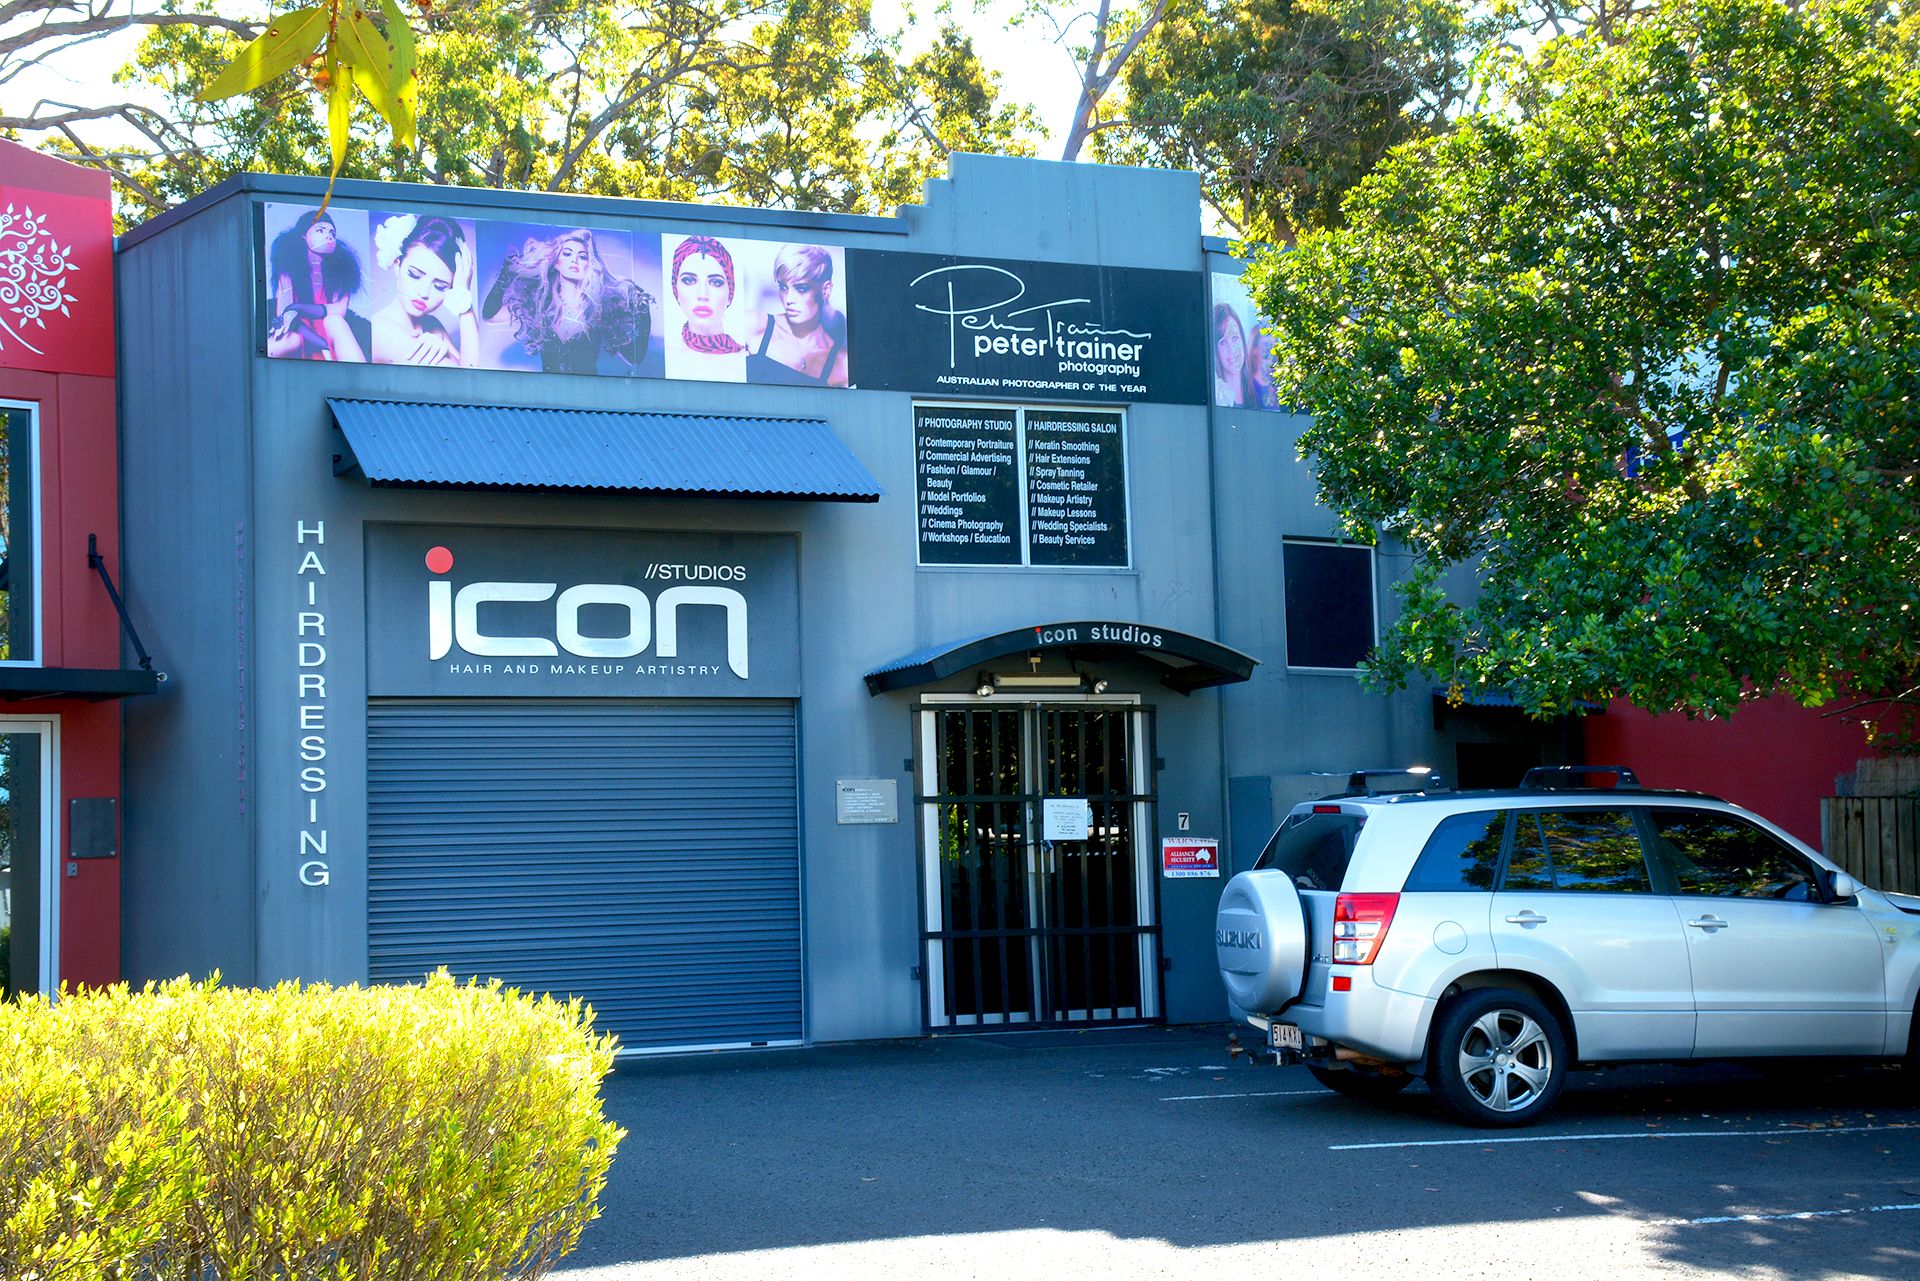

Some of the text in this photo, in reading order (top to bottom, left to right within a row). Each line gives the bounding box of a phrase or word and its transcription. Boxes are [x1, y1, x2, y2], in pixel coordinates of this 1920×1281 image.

[974, 333, 1143, 361] peter trainer
[1059, 360, 1140, 377] photography
[937, 375, 1146, 393] AUSTRALIAN PHOTOGRAPHER OF THE YEAR
[925, 418, 982, 430] PHOTOGRAPHY
[984, 420, 1012, 431] STUDIO
[1034, 422, 1089, 432] HAIRDRESSING
[1091, 424, 1117, 433] SALON
[926, 438, 975, 450] Contemporary
[977, 440, 1014, 449] Portraiture
[1035, 441, 1060, 450] Keratin
[1061, 441, 1100, 454] Smoothing
[926, 451, 969, 461] Commercial
[971, 452, 1011, 465] Advertising
[1035, 454, 1050, 463] Hair
[1052, 454, 1090, 464] Extensions
[927, 465, 955, 474] Fashion
[962, 466, 992, 475] Glamour
[1035, 467, 1056, 479] Spray
[1057, 468, 1085, 479] Tanning
[927, 478, 952, 490] Beauty
[1036, 481, 1070, 490] Cosmetic
[1071, 482, 1098, 491] Retailer
[928, 491, 950, 502] Model
[952, 492, 986, 503] Portfolios
[1037, 494, 1065, 505] Makeup
[1066, 496, 1093, 506] Artistry
[927, 505, 963, 516] Weddings
[1038, 508, 1065, 519] Makeup
[1067, 508, 1096, 518] Lessons
[928, 519, 956, 528] Cinema
[958, 520, 1004, 532] Photography
[1038, 521, 1068, 533] Wedding
[1070, 522, 1108, 532] Specialists
[928, 532, 968, 544] Workshops
[975, 533, 1010, 544] Education
[1039, 535, 1063, 546] Beauty
[1065, 535, 1095, 545] Services
[424, 546, 749, 680] icon
[1035, 624, 1162, 647] icon studios
[450, 663, 721, 676] HAIR AND MAKEUP ARTISTRY
[297, 520, 330, 887] HAIRDRESSING
[1179, 815, 1188, 828] 7
[1216, 928, 1262, 949] SUZUKI
